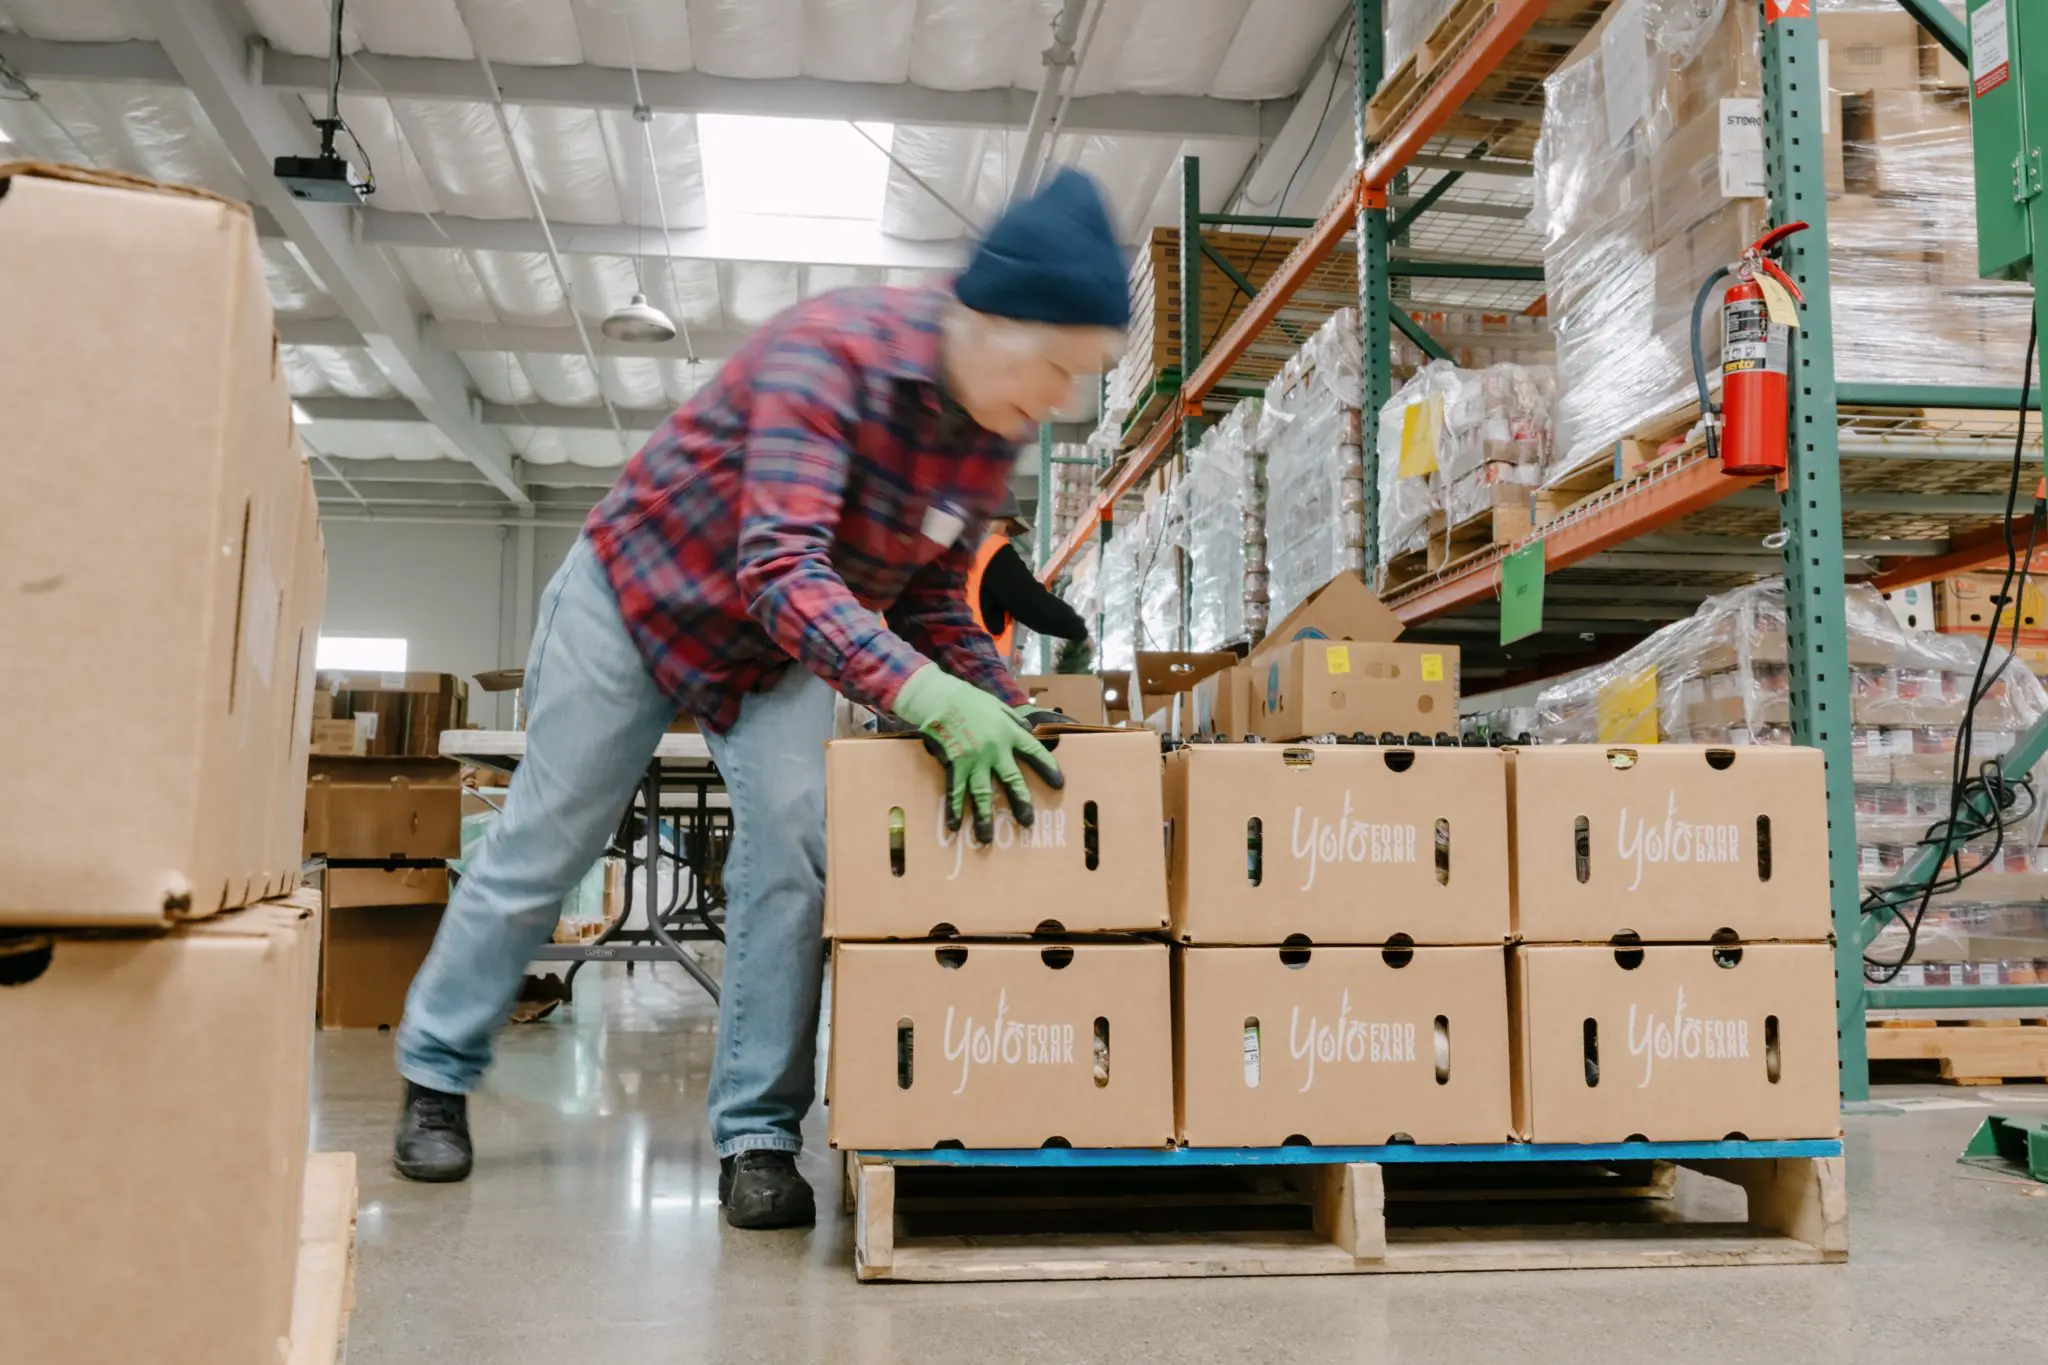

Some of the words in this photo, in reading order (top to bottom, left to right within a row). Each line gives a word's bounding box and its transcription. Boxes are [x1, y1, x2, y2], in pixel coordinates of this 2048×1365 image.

[1371, 824, 1416, 843] FOOD
[1696, 824, 1740, 843] FOOD
[1371, 843, 1416, 862] BANK
[1696, 843, 1740, 862] BANK
[1027, 1025, 1074, 1044] FOOD
[1370, 1023, 1416, 1042] FOOD
[1704, 1020, 1750, 1039] FOOD
[1027, 1044, 1074, 1064] BANK
[1370, 1042, 1416, 1062] BANK
[1704, 1039, 1750, 1058] BANK
